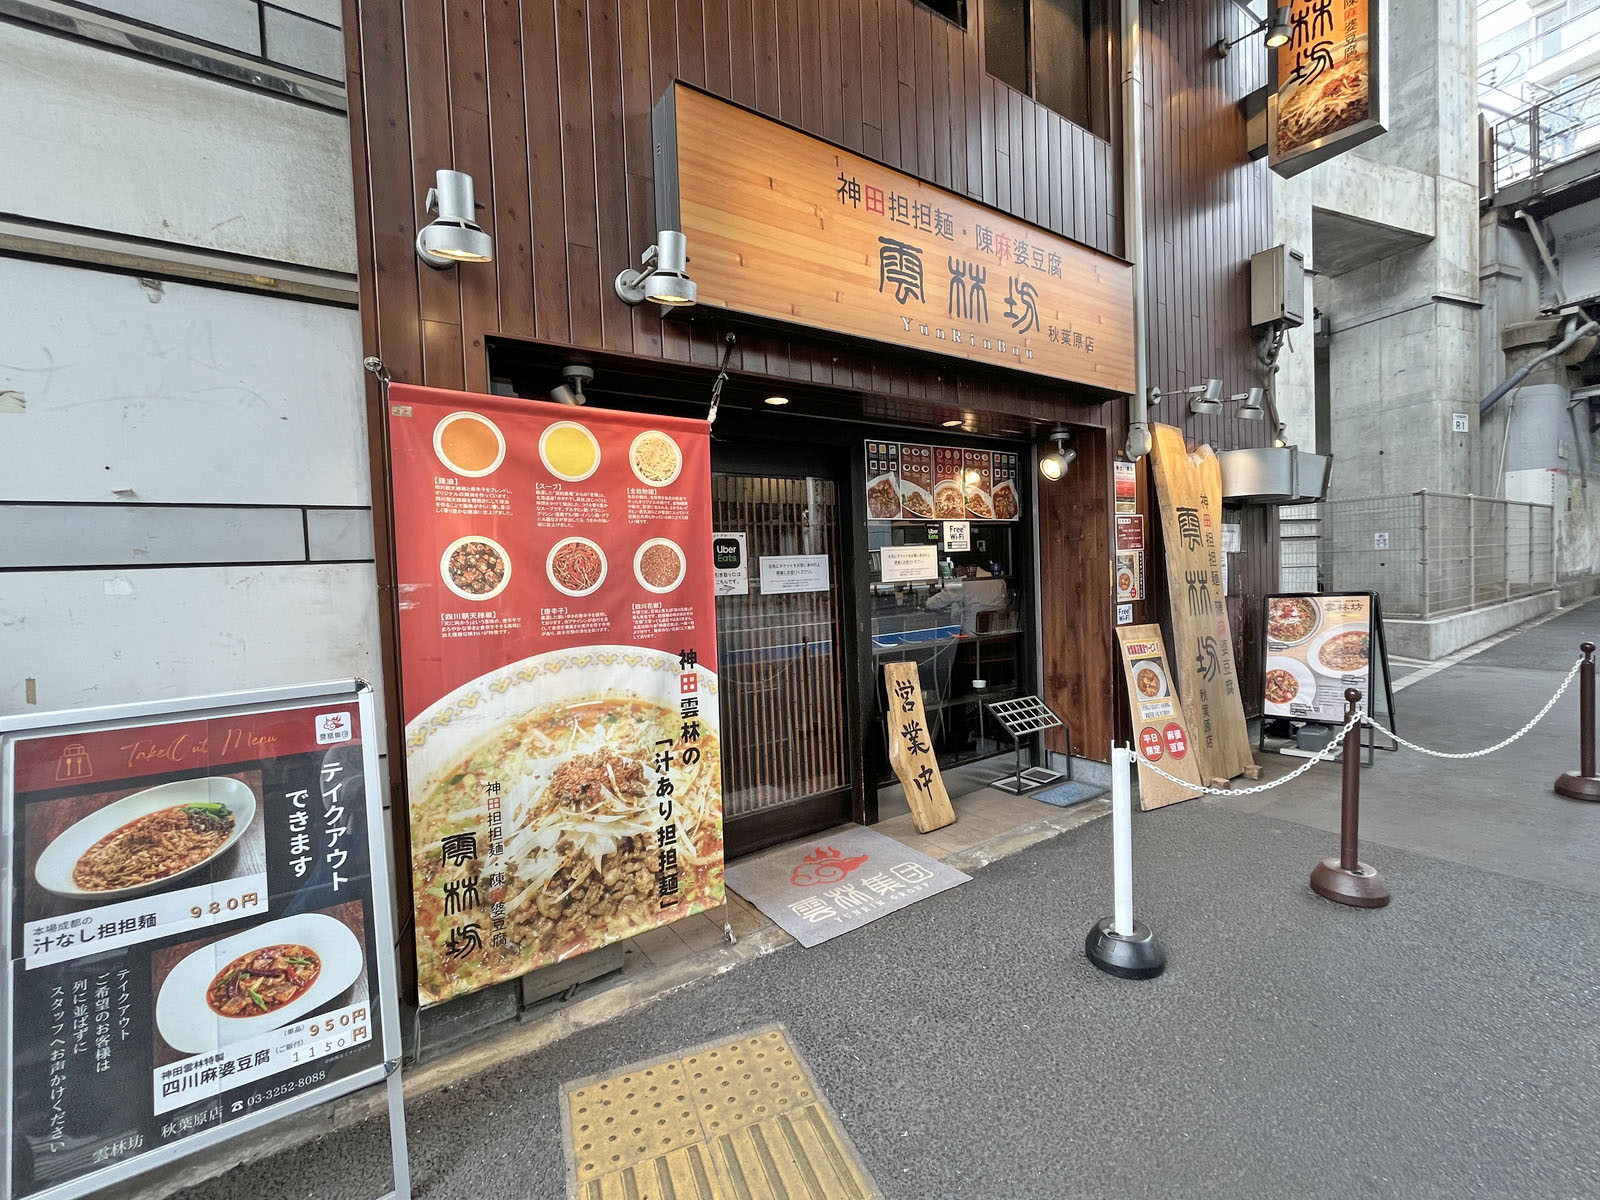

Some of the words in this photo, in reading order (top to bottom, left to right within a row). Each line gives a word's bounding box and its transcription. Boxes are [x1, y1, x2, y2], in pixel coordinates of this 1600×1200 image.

[1289, 0, 1335, 87] 林坊
[836, 171, 1063, 280] 神田担担麺・陳麻婆豆腐
[878, 235, 1041, 335] 雲林坊
[900, 315, 1034, 360] YunRinBou
[1047, 325, 1095, 354] 秋葉原店
[1455, 420, 1465, 430] R1
[716, 545, 737, 554] Uber
[949, 525, 964, 533] Free
[717, 553, 737, 562] Eats
[1176, 507, 1220, 683] 雲林坊
[679, 649, 701, 766] 神田雲林の
[221, 729, 278, 756] Menu
[895, 679, 933, 804] 営業中
[1143, 733, 1158, 743] 平日
[1145, 746, 1162, 756] 限定
[1167, 729, 1182, 740] 麻婆
[1169, 742, 1185, 753] 豆腐
[285, 789, 313, 878] できます
[320, 762, 349, 892] テイクアウト
[654, 737, 680, 910] 「汁あり担担麺」
[189, 891, 259, 919] 980円
[441, 832, 483, 960] 雲林坊
[32, 915, 93, 937] 本場成都の
[32, 912, 157, 954] 汁なし担担麺
[72, 978, 88, 1054] 列に並ばずに
[94, 972, 111, 1073] ご希望のお客様は
[117, 968, 130, 1041] テイクアウト
[309, 1007, 367, 1037] 950円
[160, 1052, 225, 1080] 神田雲林特製
[291, 1025, 367, 1063] 1150円
[50, 986, 66, 1153] スタッフへお声かけください
[162, 1048, 271, 1098] 四川麻婆豆腐
[92, 1134, 144, 1164] 雲林坊
[160, 1105, 224, 1138] 秋葉原店
[247, 1070, 326, 1107] 03-3252-8088
